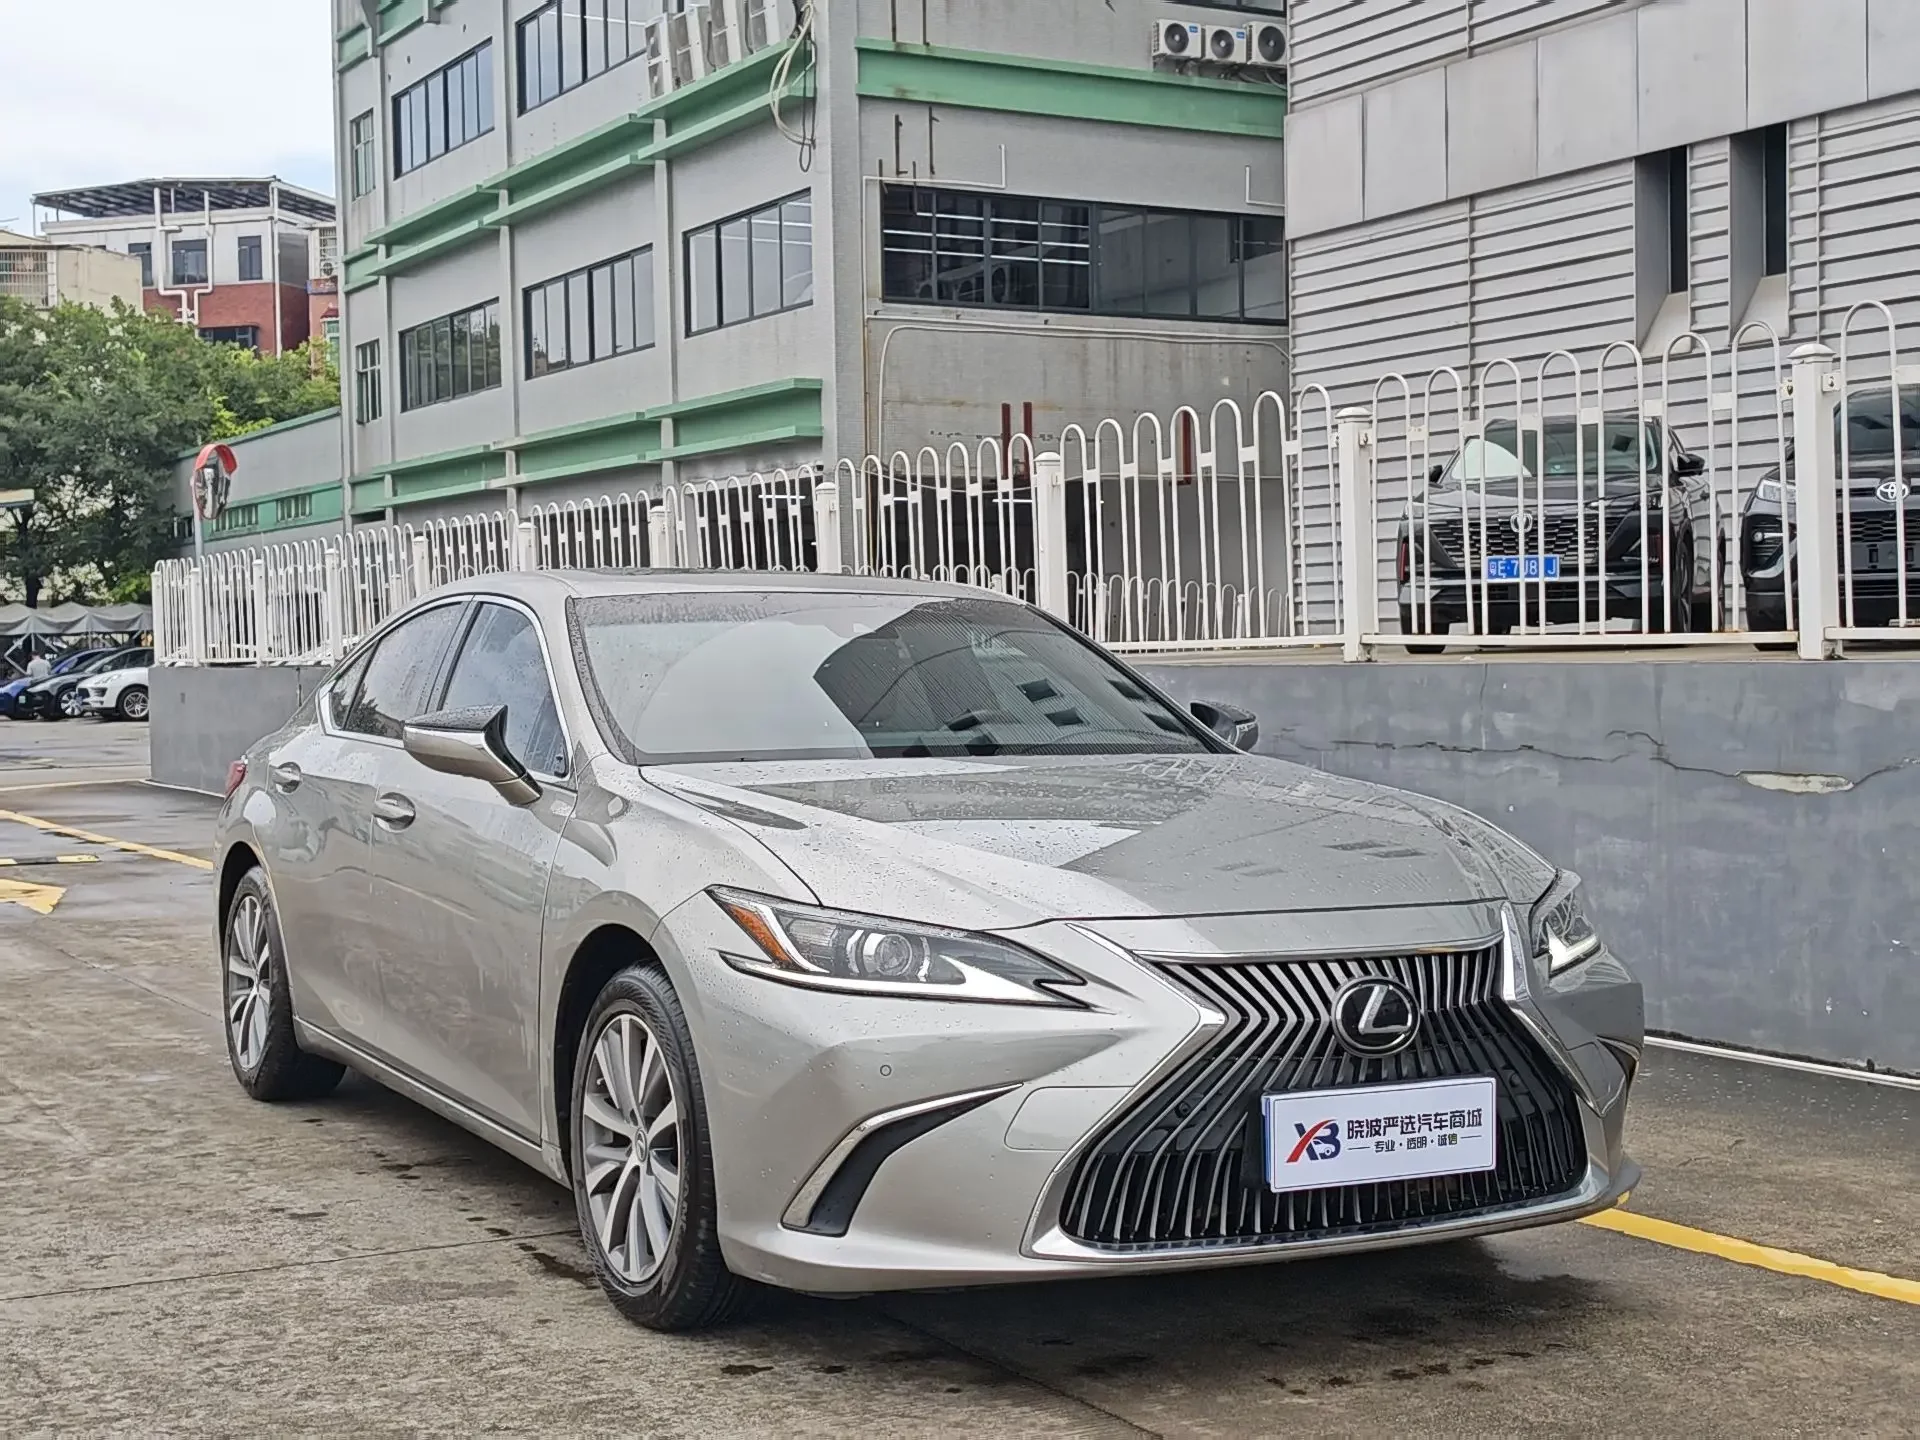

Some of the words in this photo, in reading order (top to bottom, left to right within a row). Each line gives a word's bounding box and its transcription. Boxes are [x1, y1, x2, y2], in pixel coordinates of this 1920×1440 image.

[1346, 1108, 1483, 1140] 晓波严选汽车商城
